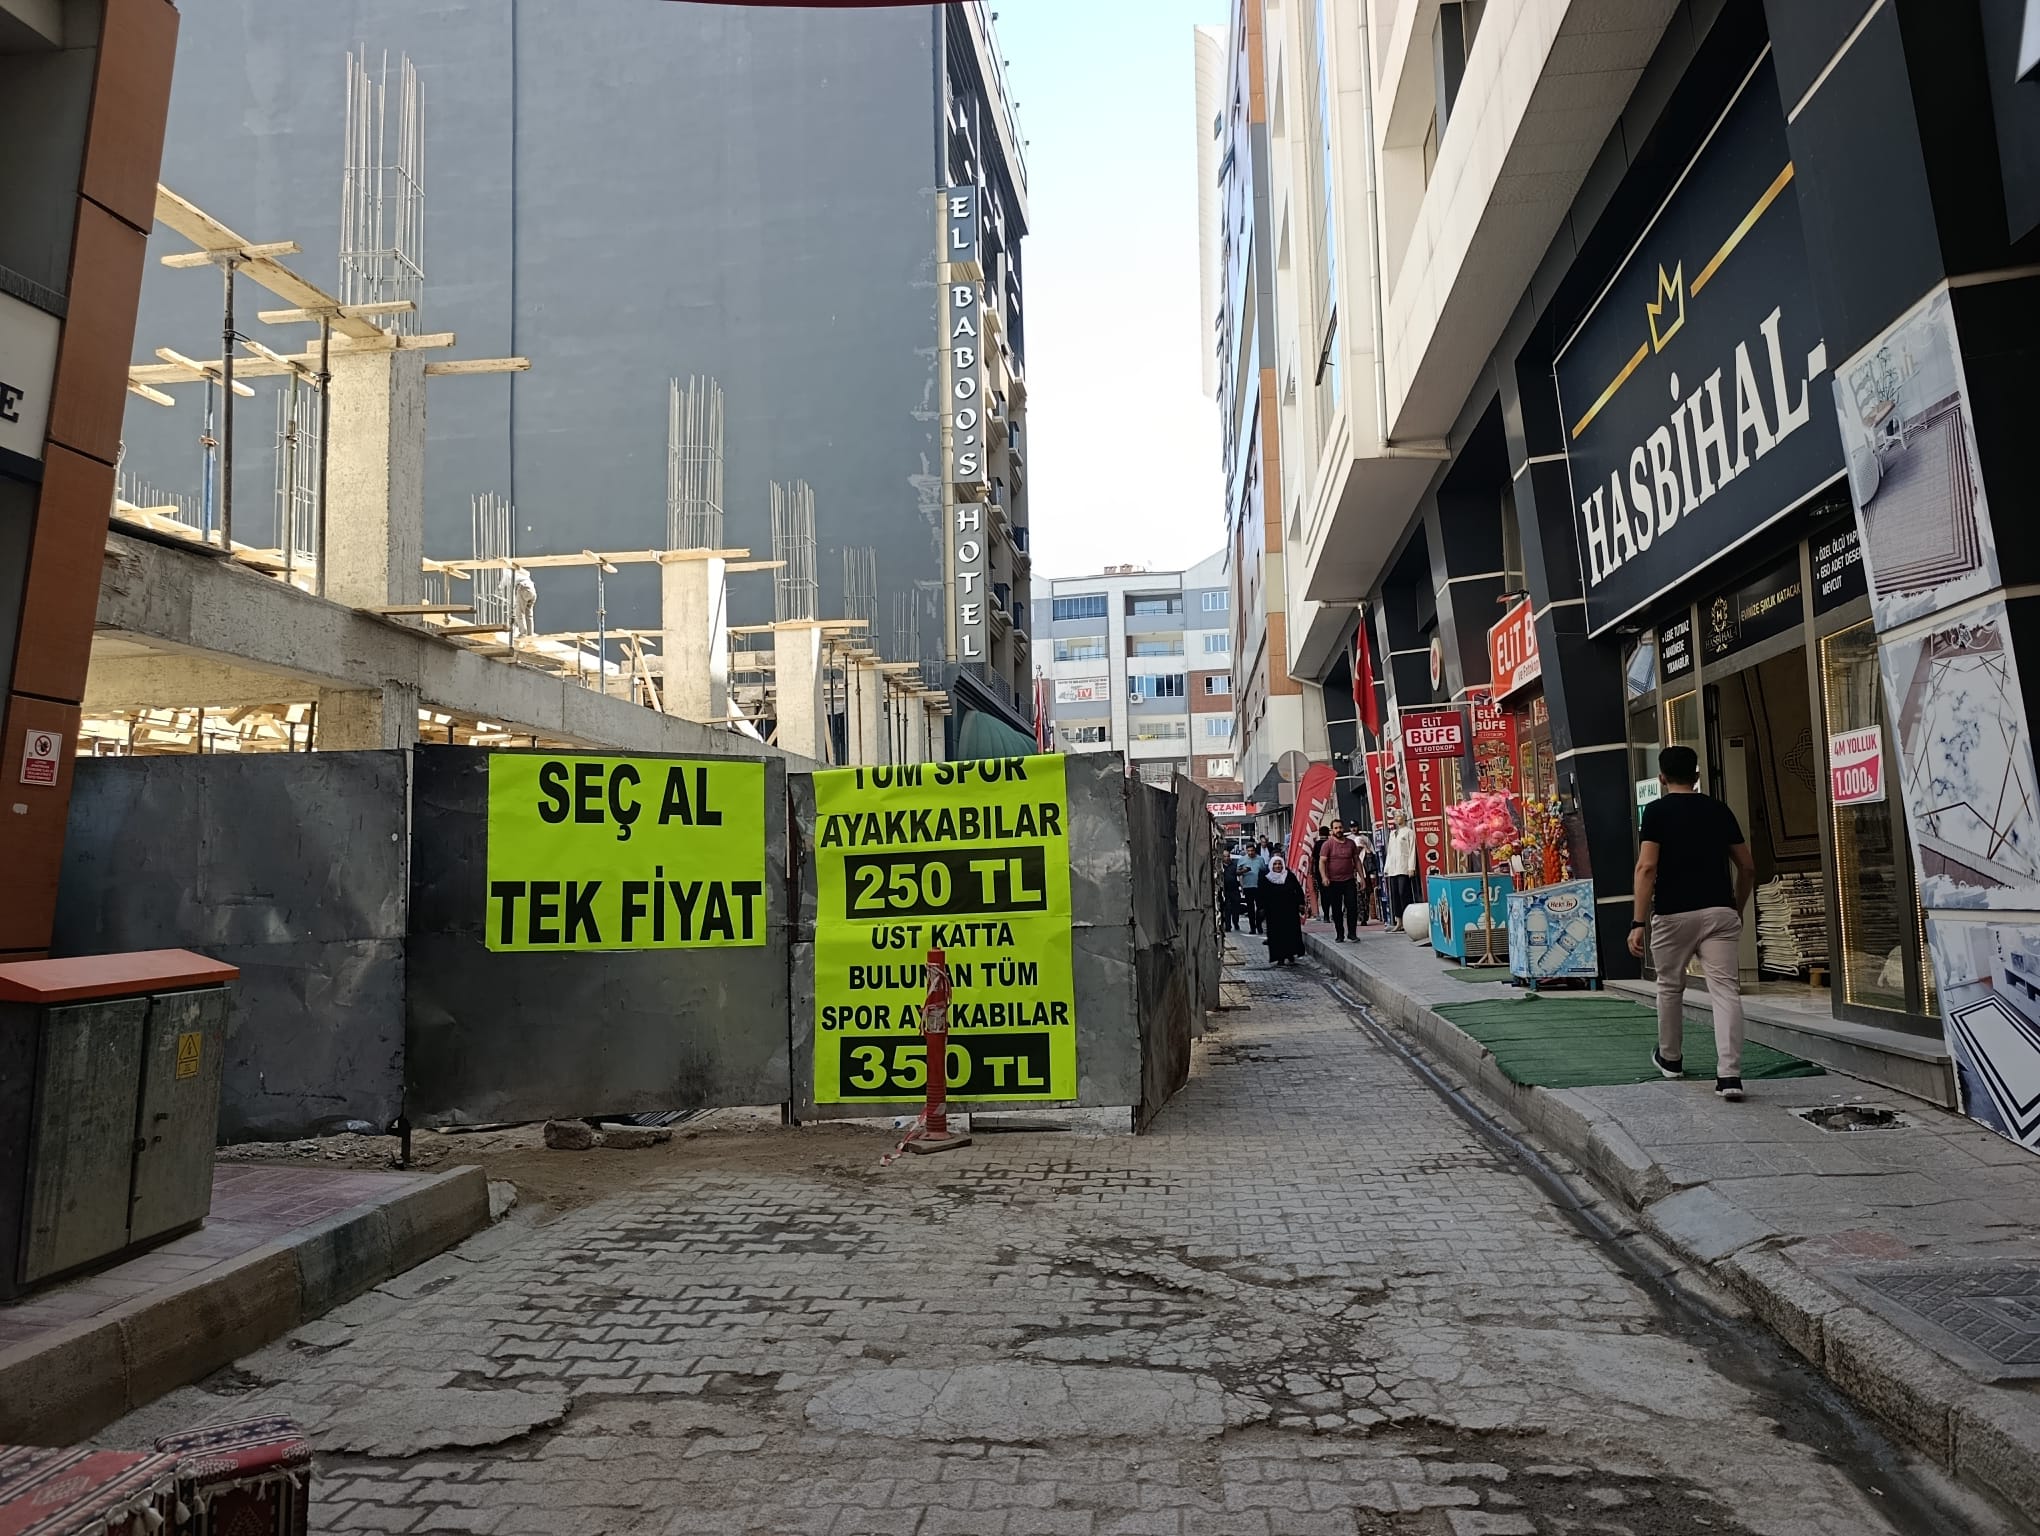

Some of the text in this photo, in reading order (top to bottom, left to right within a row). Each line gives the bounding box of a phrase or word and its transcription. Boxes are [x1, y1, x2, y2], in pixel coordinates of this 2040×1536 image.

[950, 196, 981, 657] EL BABOO'S HOTEL
[1819, 545, 1832, 561] ÖZEL
[1832, 533, 1846, 553] ÖLÇÜ
[1831, 555, 1844, 573] ADET
[1822, 575, 1842, 596] MEVCUT
[1411, 728, 1456, 744] BÜFE
[1835, 733, 1877, 754] 4M YOLLUK
[1418, 759, 1432, 812] DİKAL
[538, 761, 722, 842] SEÇ AL
[1207, 803, 1244, 811] ECZANE
[820, 802, 1062, 848] AYAKKABILAR
[854, 858, 1042, 910] 250 TL
[491, 865, 762, 944] TEK FİYAT
[872, 922, 1014, 950] ÜST KATTA
[981, 957, 1038, 987] TÜM
[821, 1004, 890, 1030] SPOR
[849, 1044, 1044, 1090] 350 TL
